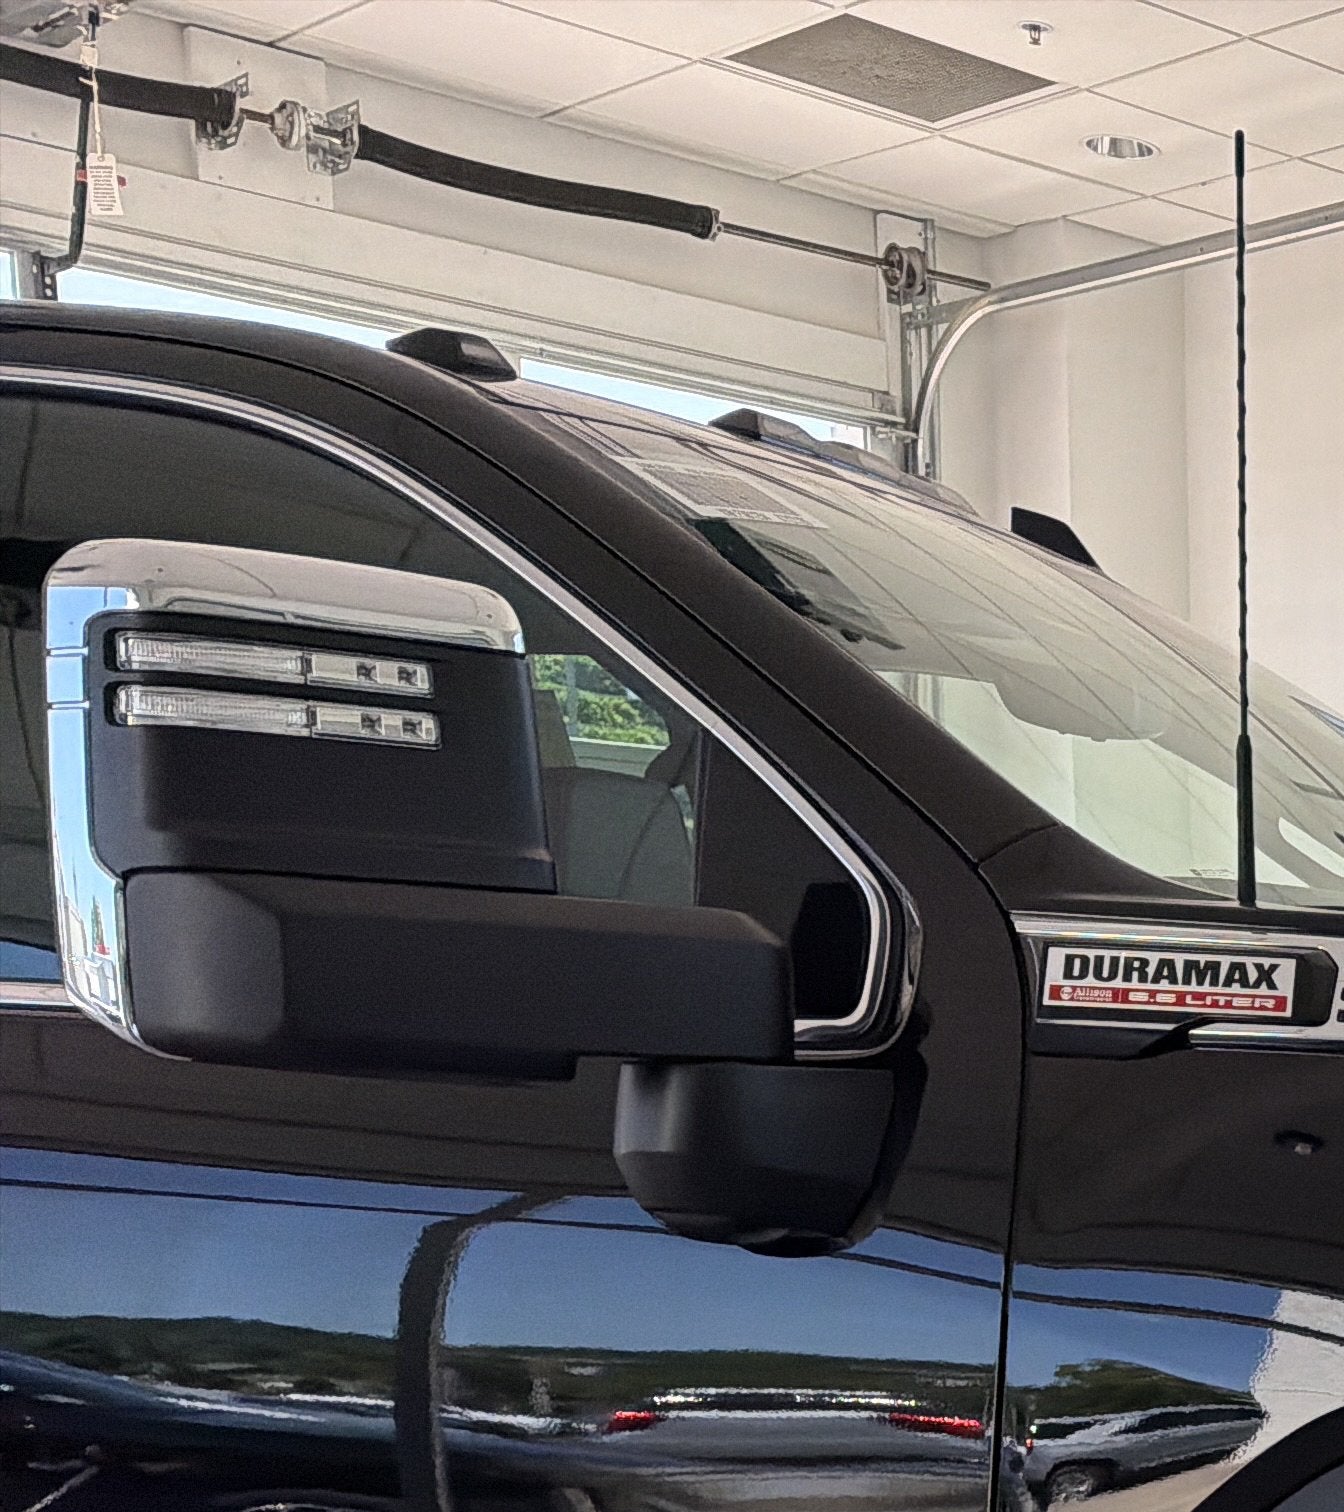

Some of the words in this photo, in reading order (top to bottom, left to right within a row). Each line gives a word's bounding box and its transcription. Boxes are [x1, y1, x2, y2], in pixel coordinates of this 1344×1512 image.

[1062, 953, 1281, 991] DURAMAX
[1128, 991, 1177, 1004] 6.6
[1185, 994, 1277, 1009] LITER
